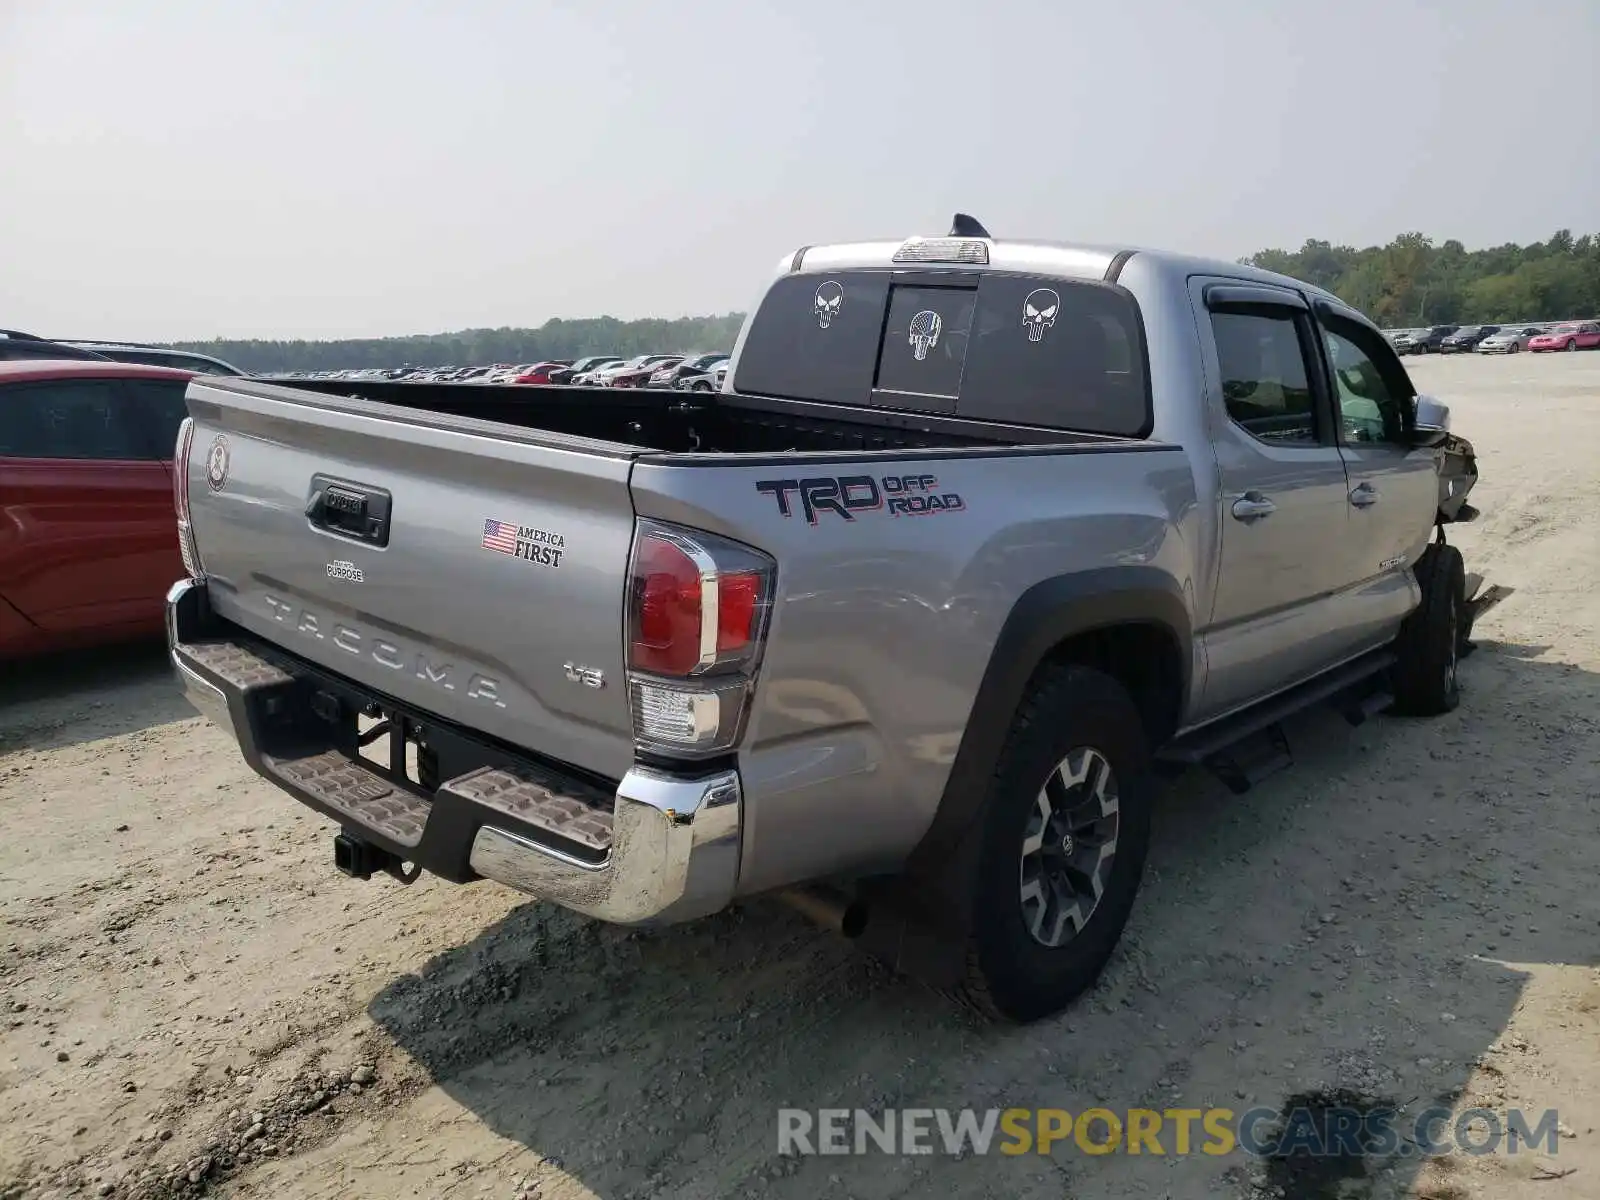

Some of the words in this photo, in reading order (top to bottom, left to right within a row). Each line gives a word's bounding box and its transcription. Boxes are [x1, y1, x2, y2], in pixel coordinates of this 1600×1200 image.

[882, 474, 939, 495] OFF
[756, 476, 884, 526] TRD
[887, 493, 966, 517] ROAD
[517, 526, 564, 547] AMERICA
[515, 540, 562, 567] FIRST
[327, 565, 362, 581] PURPOSE
[265, 594, 507, 708] TACOMA
